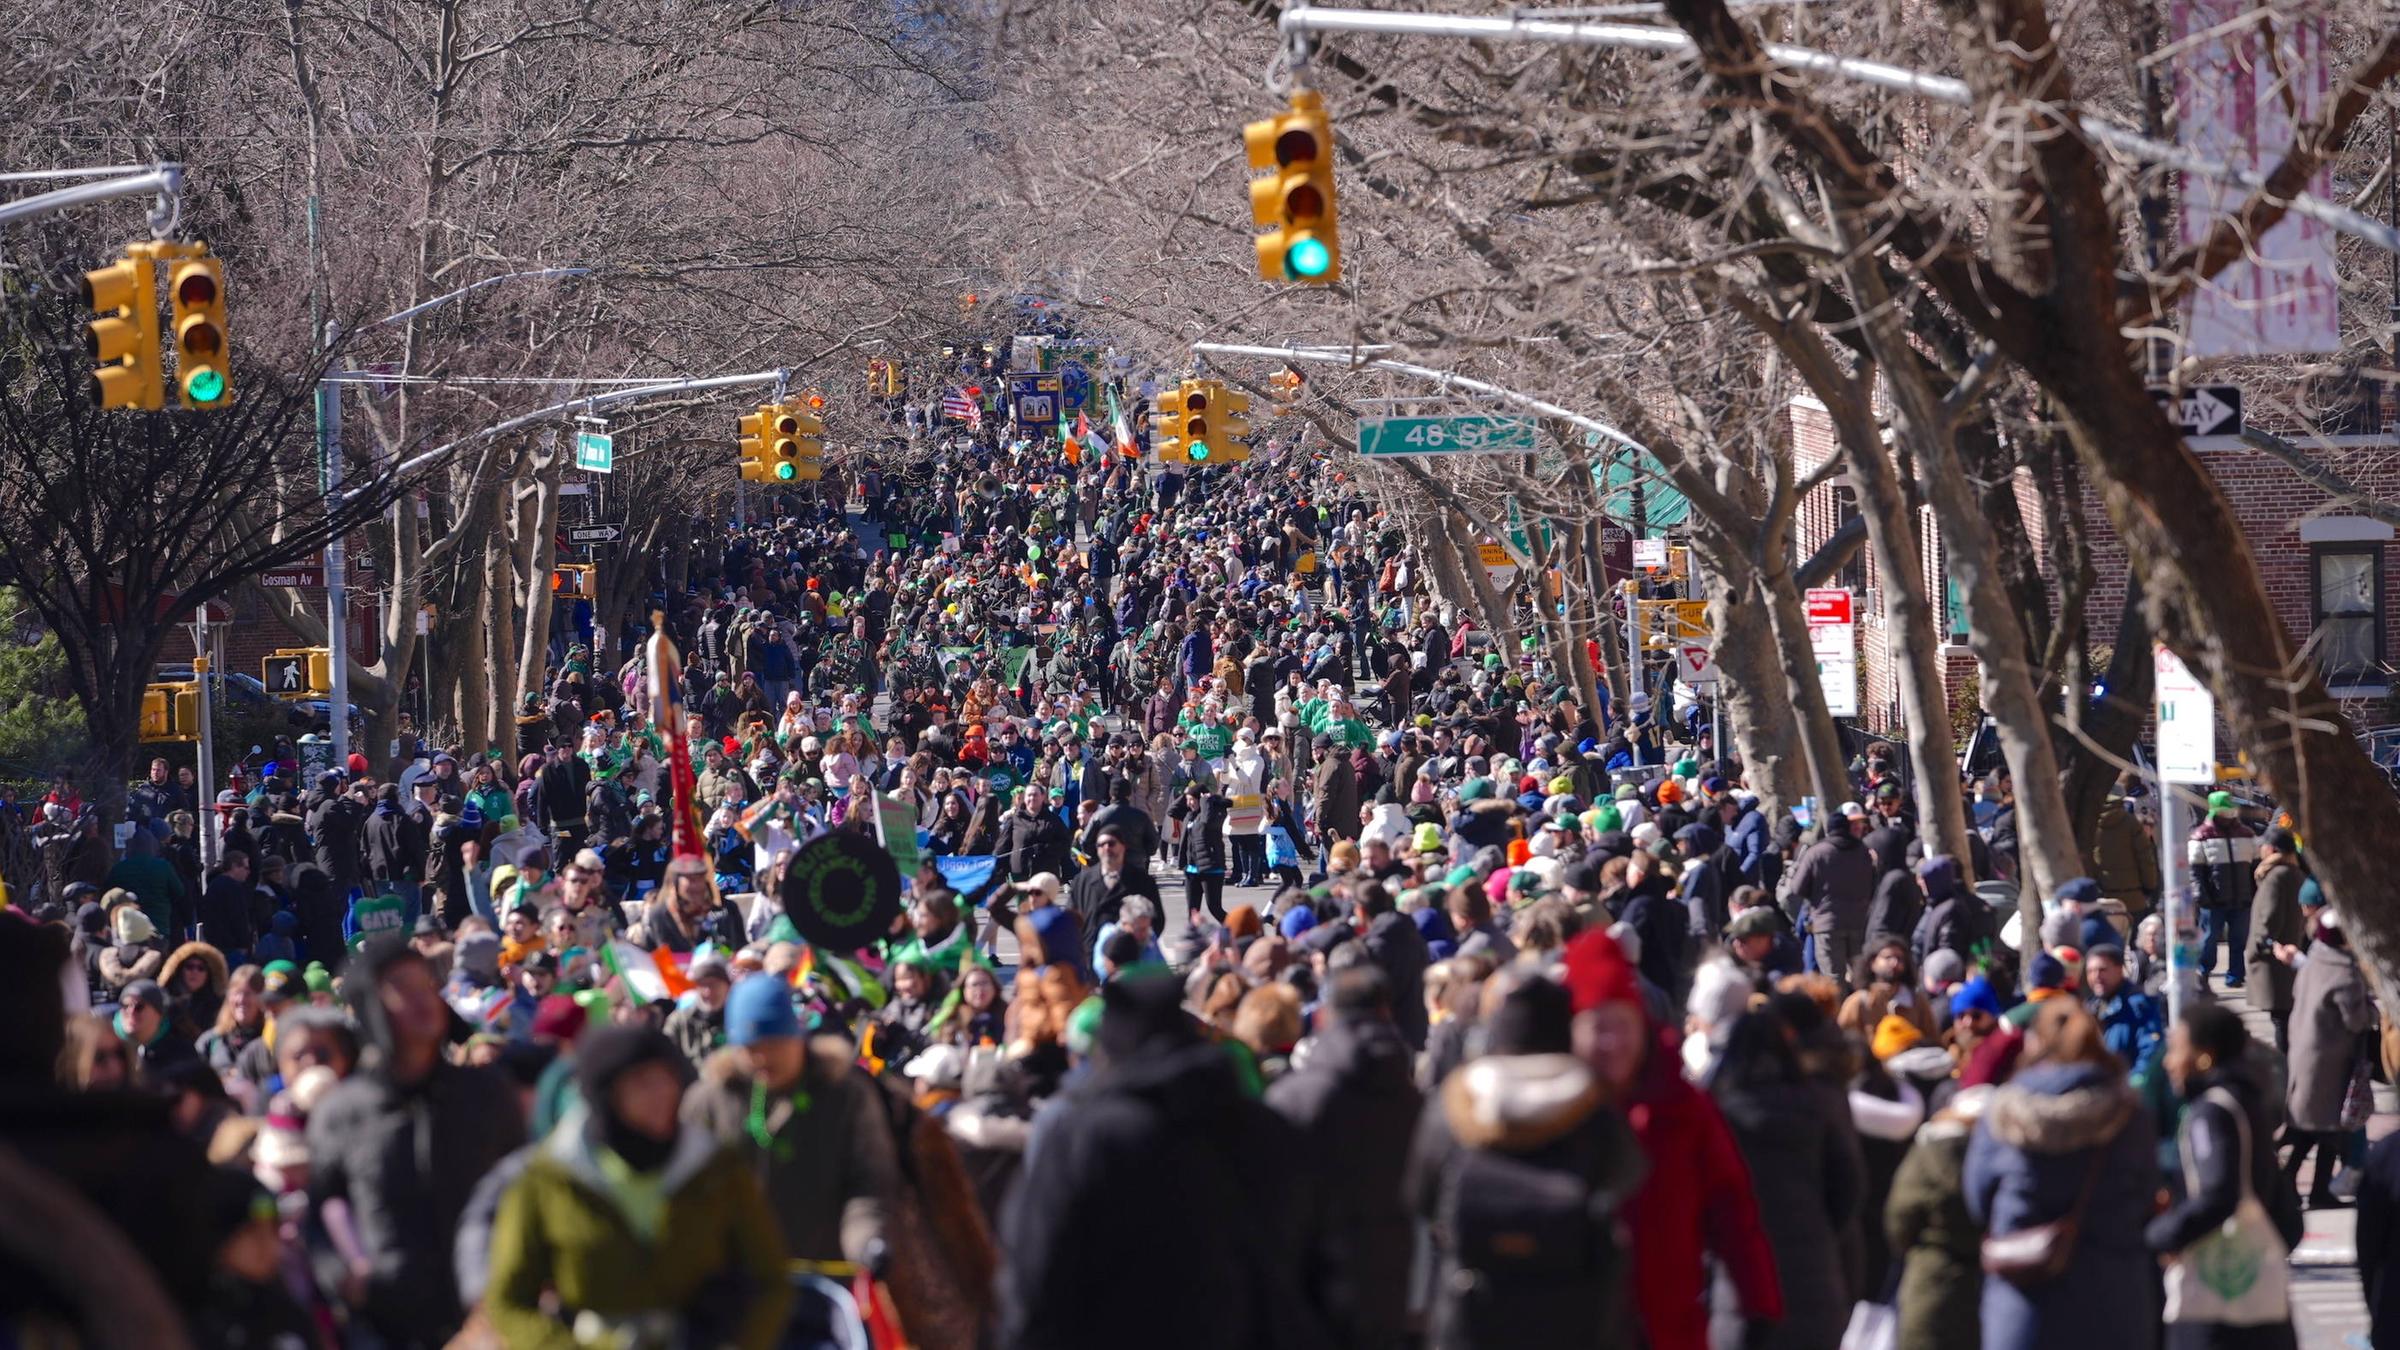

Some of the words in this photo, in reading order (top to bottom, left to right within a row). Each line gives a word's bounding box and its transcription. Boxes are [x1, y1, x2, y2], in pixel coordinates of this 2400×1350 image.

[1404, 424, 1443, 447] 48
[577, 531, 592, 539] ONE
[598, 529, 614, 538] WAY
[262, 573, 297, 586] Gosman
[300, 573, 313, 585] Av
